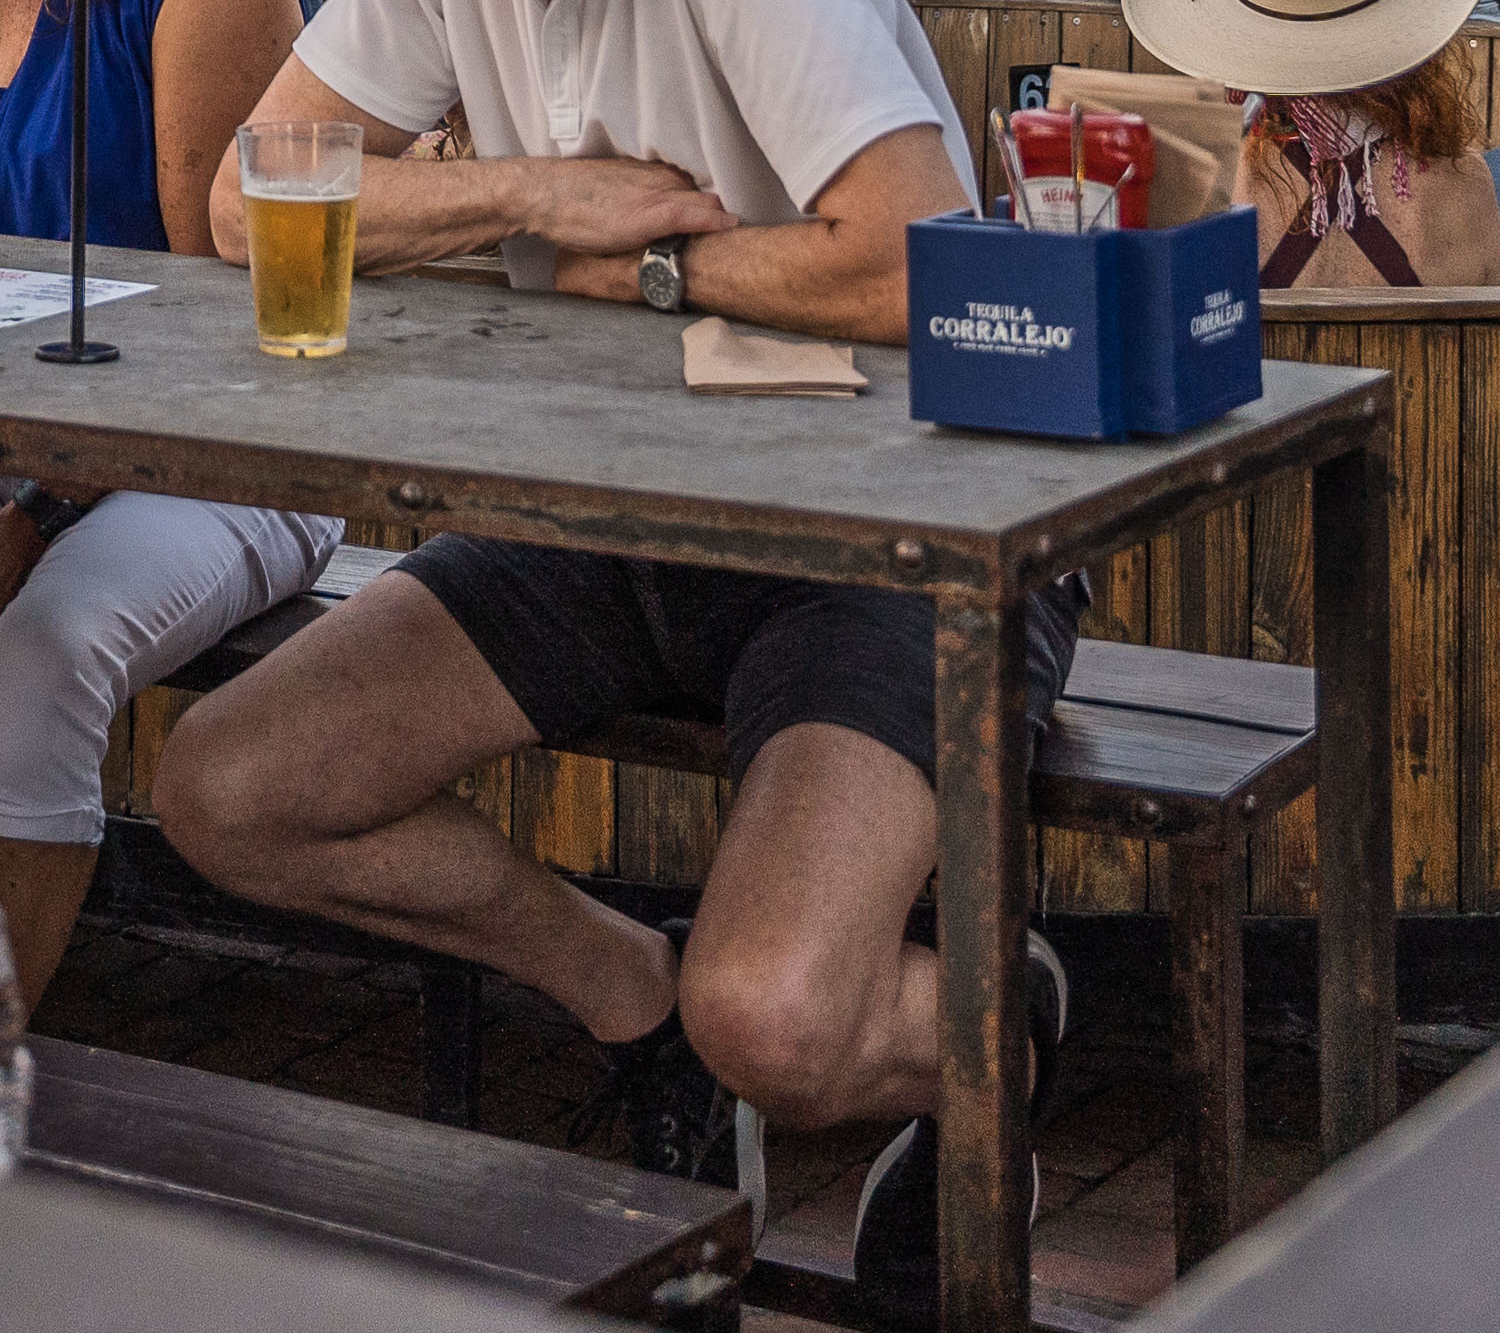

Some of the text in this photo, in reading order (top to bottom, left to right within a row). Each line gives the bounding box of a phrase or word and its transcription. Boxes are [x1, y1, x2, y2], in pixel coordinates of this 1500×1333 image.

[1019, 74, 1052, 110] 6
[1041, 187, 1083, 203] HEIN
[966, 301, 1034, 322] TEQUILA
[929, 315, 1073, 351] CORRALEJO
